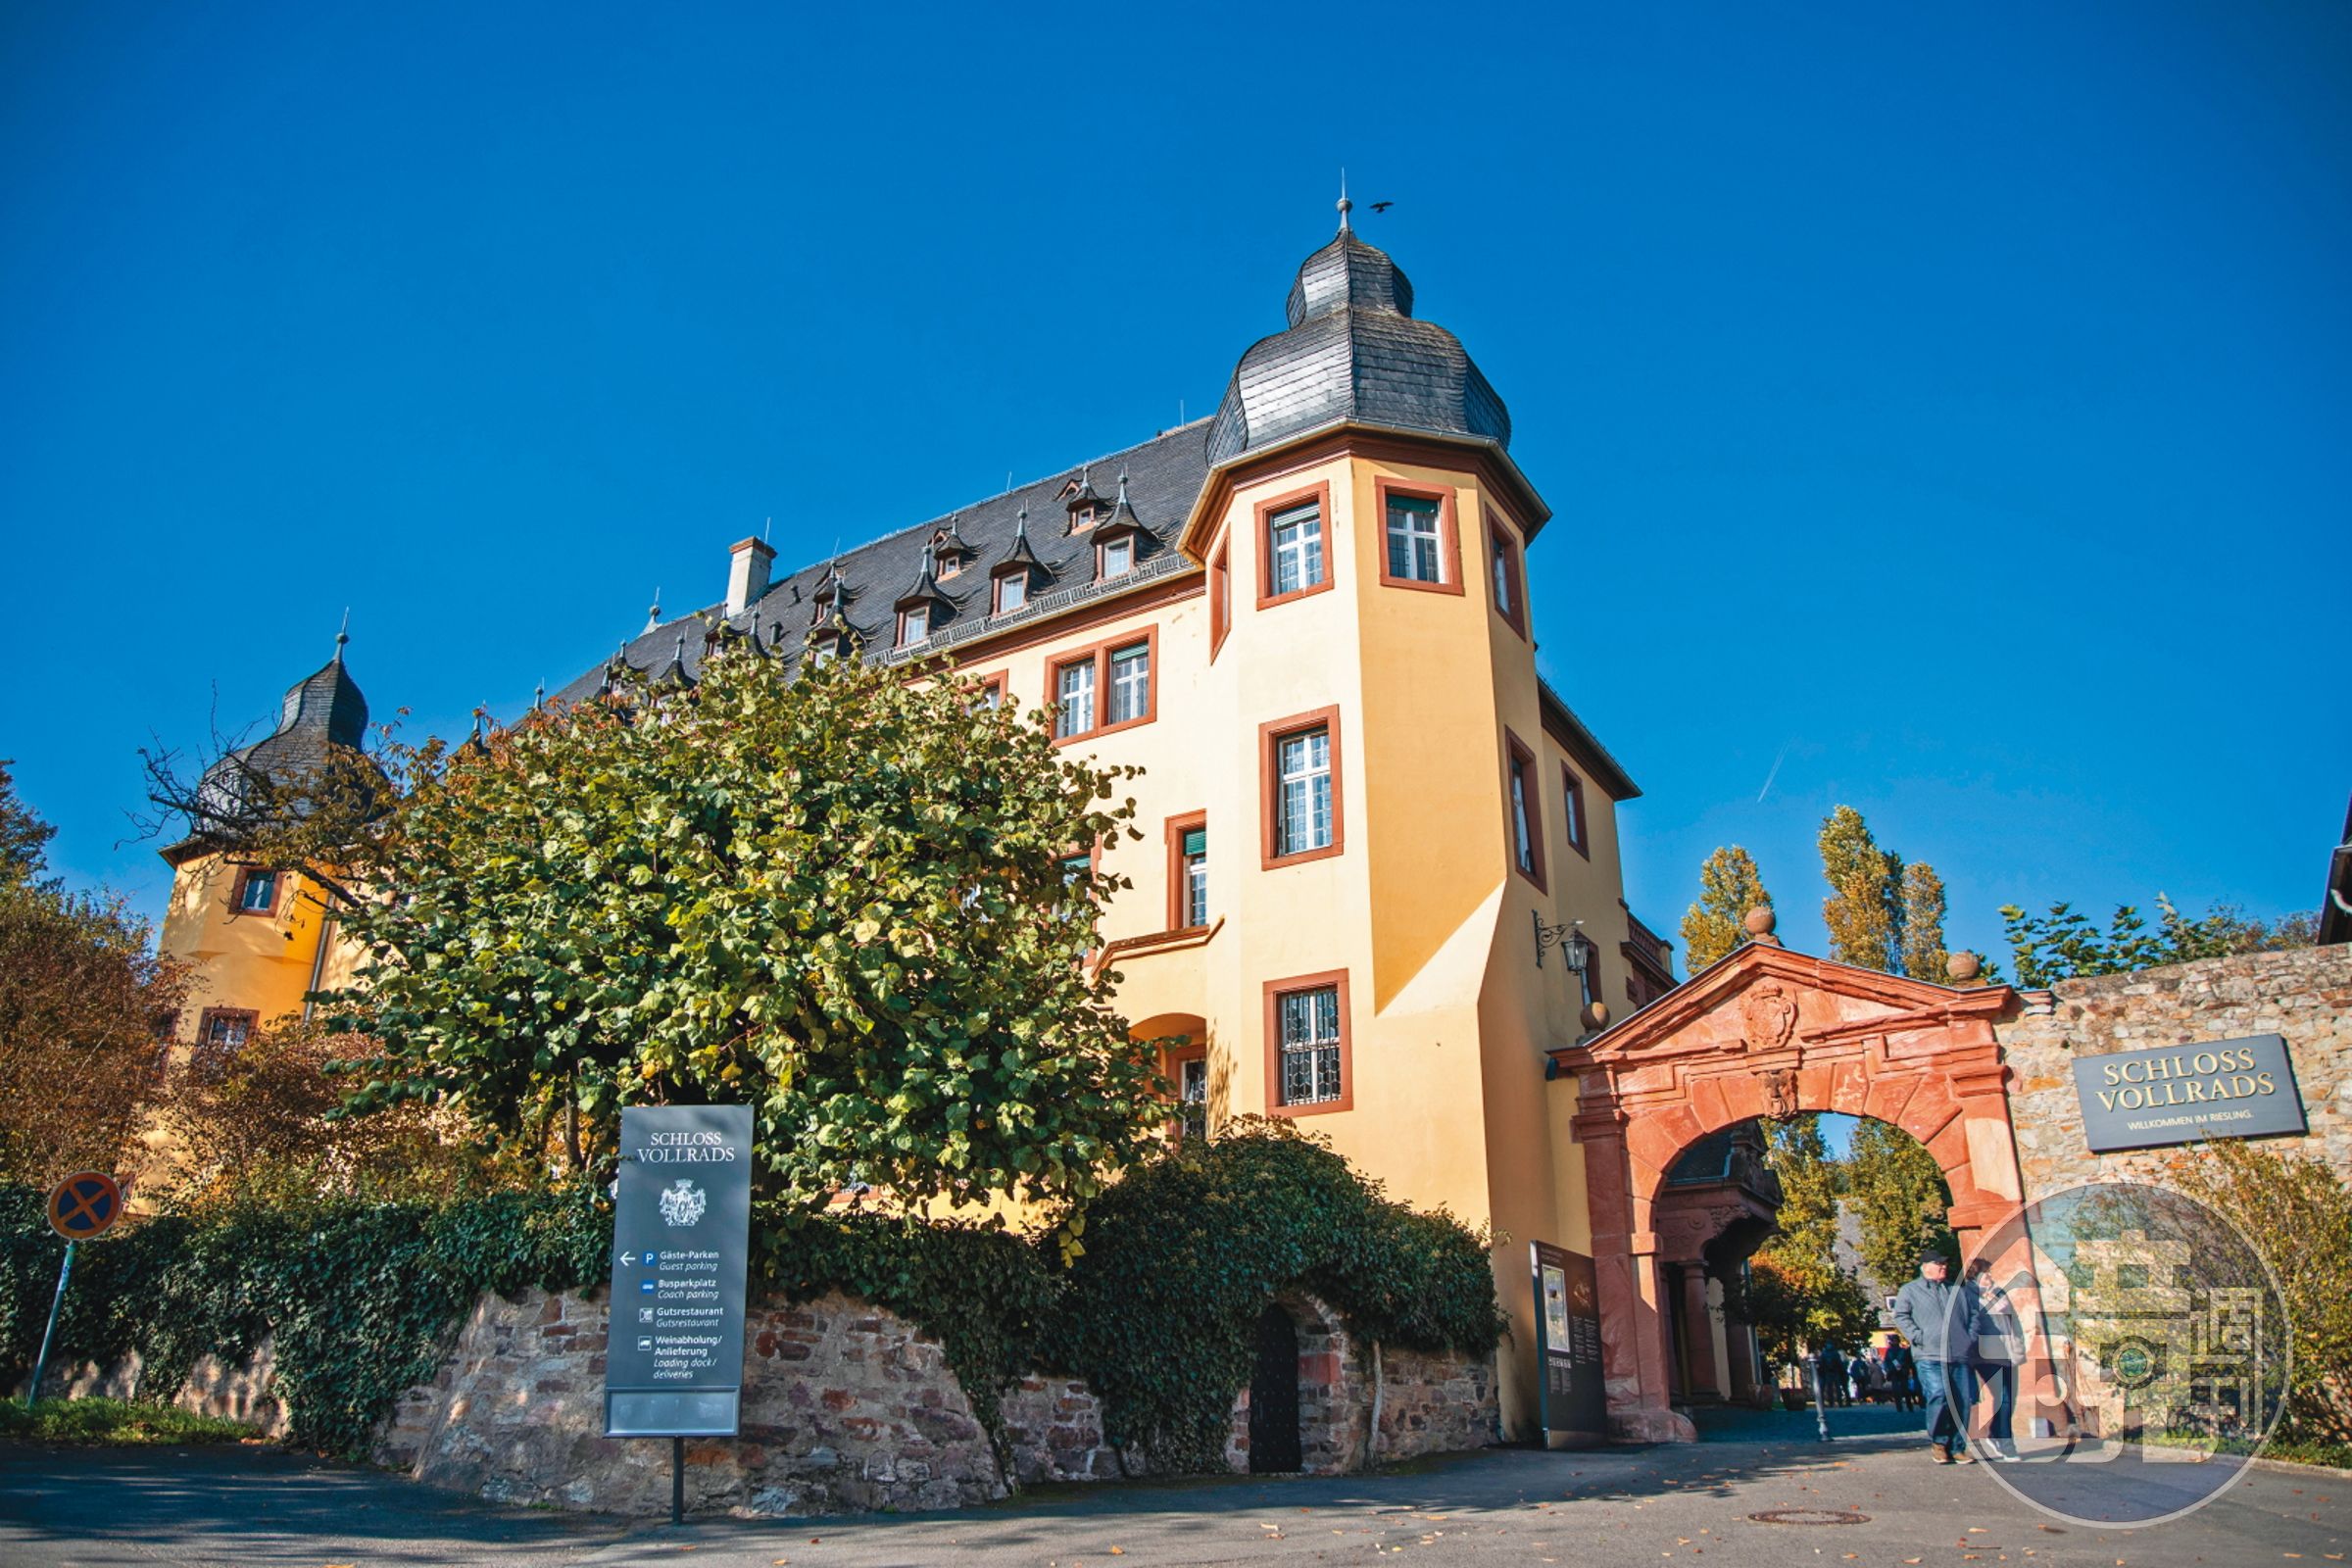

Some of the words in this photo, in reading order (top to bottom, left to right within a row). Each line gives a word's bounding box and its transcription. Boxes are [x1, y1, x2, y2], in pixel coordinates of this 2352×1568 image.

[2104, 1047, 2256, 1086] SCHLOSS
[2095, 1072, 2276, 1112] VOLLRADS
[2127, 1116, 2193, 1131] WILLKOMMEN
[2195, 1113, 2208, 1123] IM
[650, 1132, 722, 1146] SCHLOSS
[637, 1147, 735, 1163] VOLLRADS
[646, 1253, 654, 1263] P
[660, 1250, 719, 1259] Gäste-Parken
[660, 1262, 683, 1271] Guest
[685, 1261, 718, 1272] parking
[658, 1279, 717, 1289] Busparkplatz
[686, 1291, 719, 1300] parking
[657, 1307, 723, 1316] Gutsrestaurant
[656, 1318, 718, 1328] Gutsrestaurant
[655, 1335, 722, 1346] Weinabholung/
[654, 1348, 708, 1357] Anlieferung
[654, 1358, 688, 1368] Loading
[653, 1369, 693, 1379] deliveries
